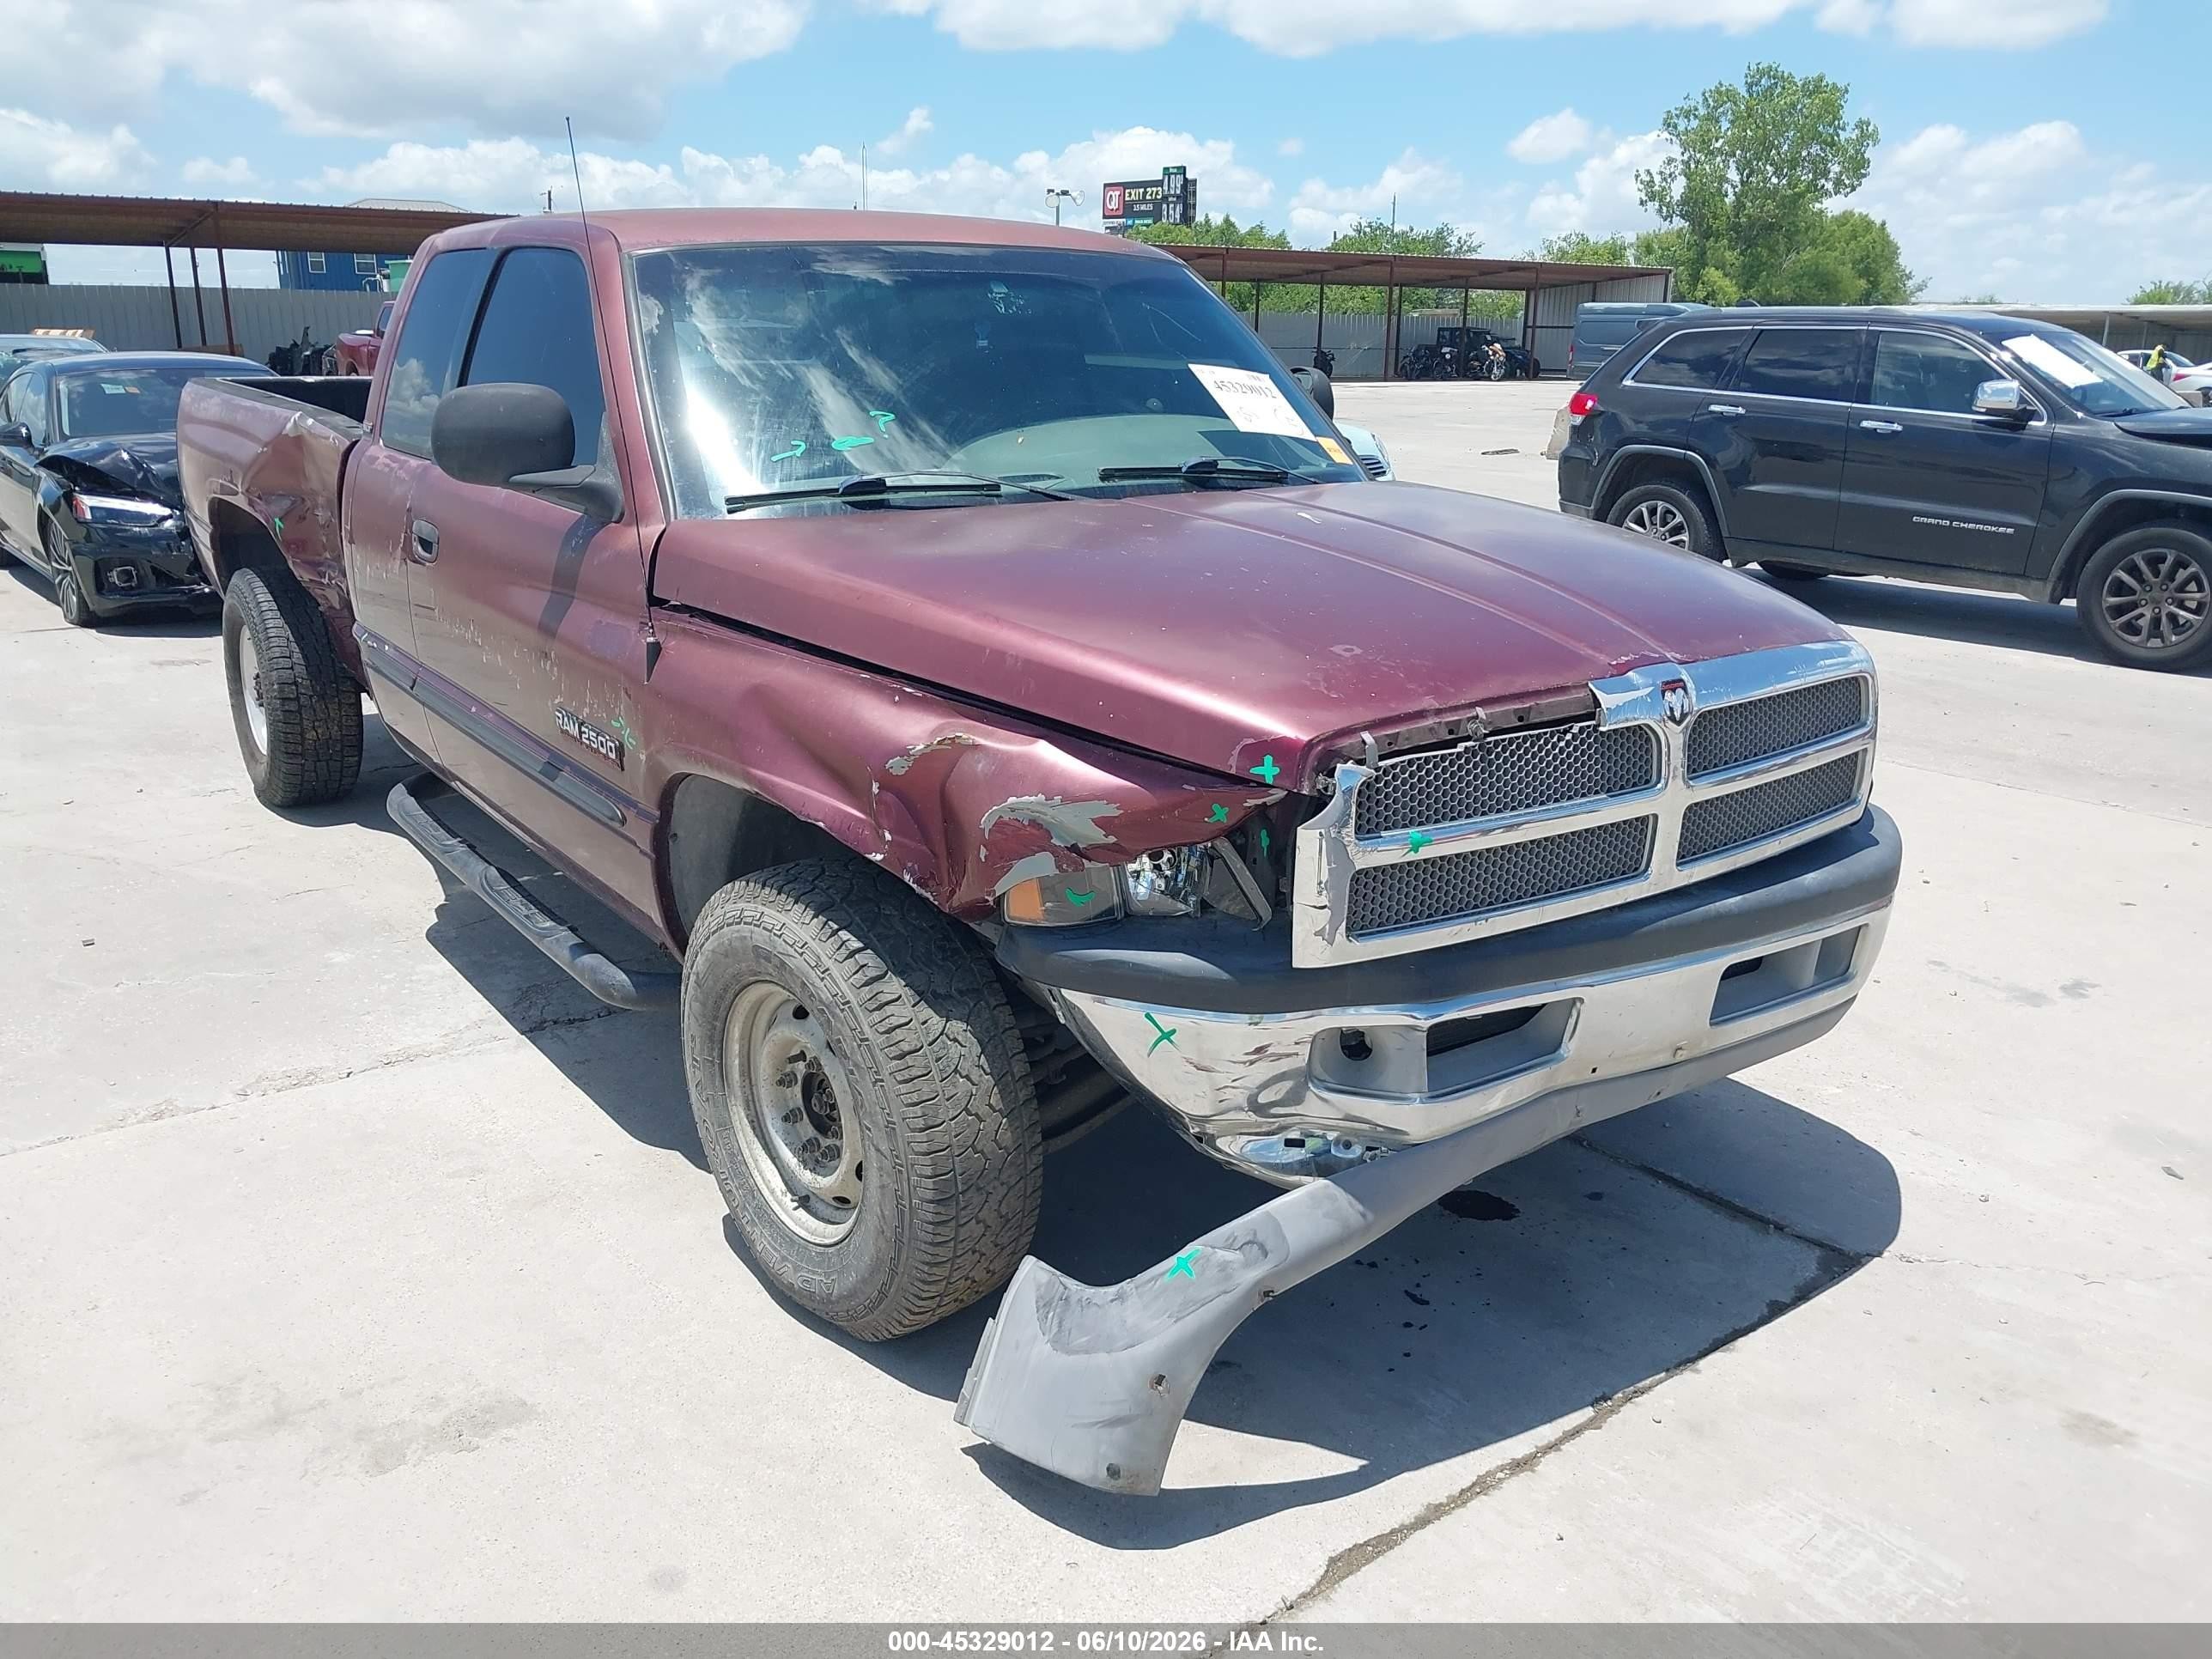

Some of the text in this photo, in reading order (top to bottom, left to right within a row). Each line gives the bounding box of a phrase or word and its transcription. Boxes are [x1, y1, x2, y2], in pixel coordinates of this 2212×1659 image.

[1125, 186, 1162, 201] EXIT 273
[1140, 202, 1153, 211] MILES
[1912, 515, 2015, 535] GRAND CHEROKEE
[555, 708, 618, 760] RAM 2500
